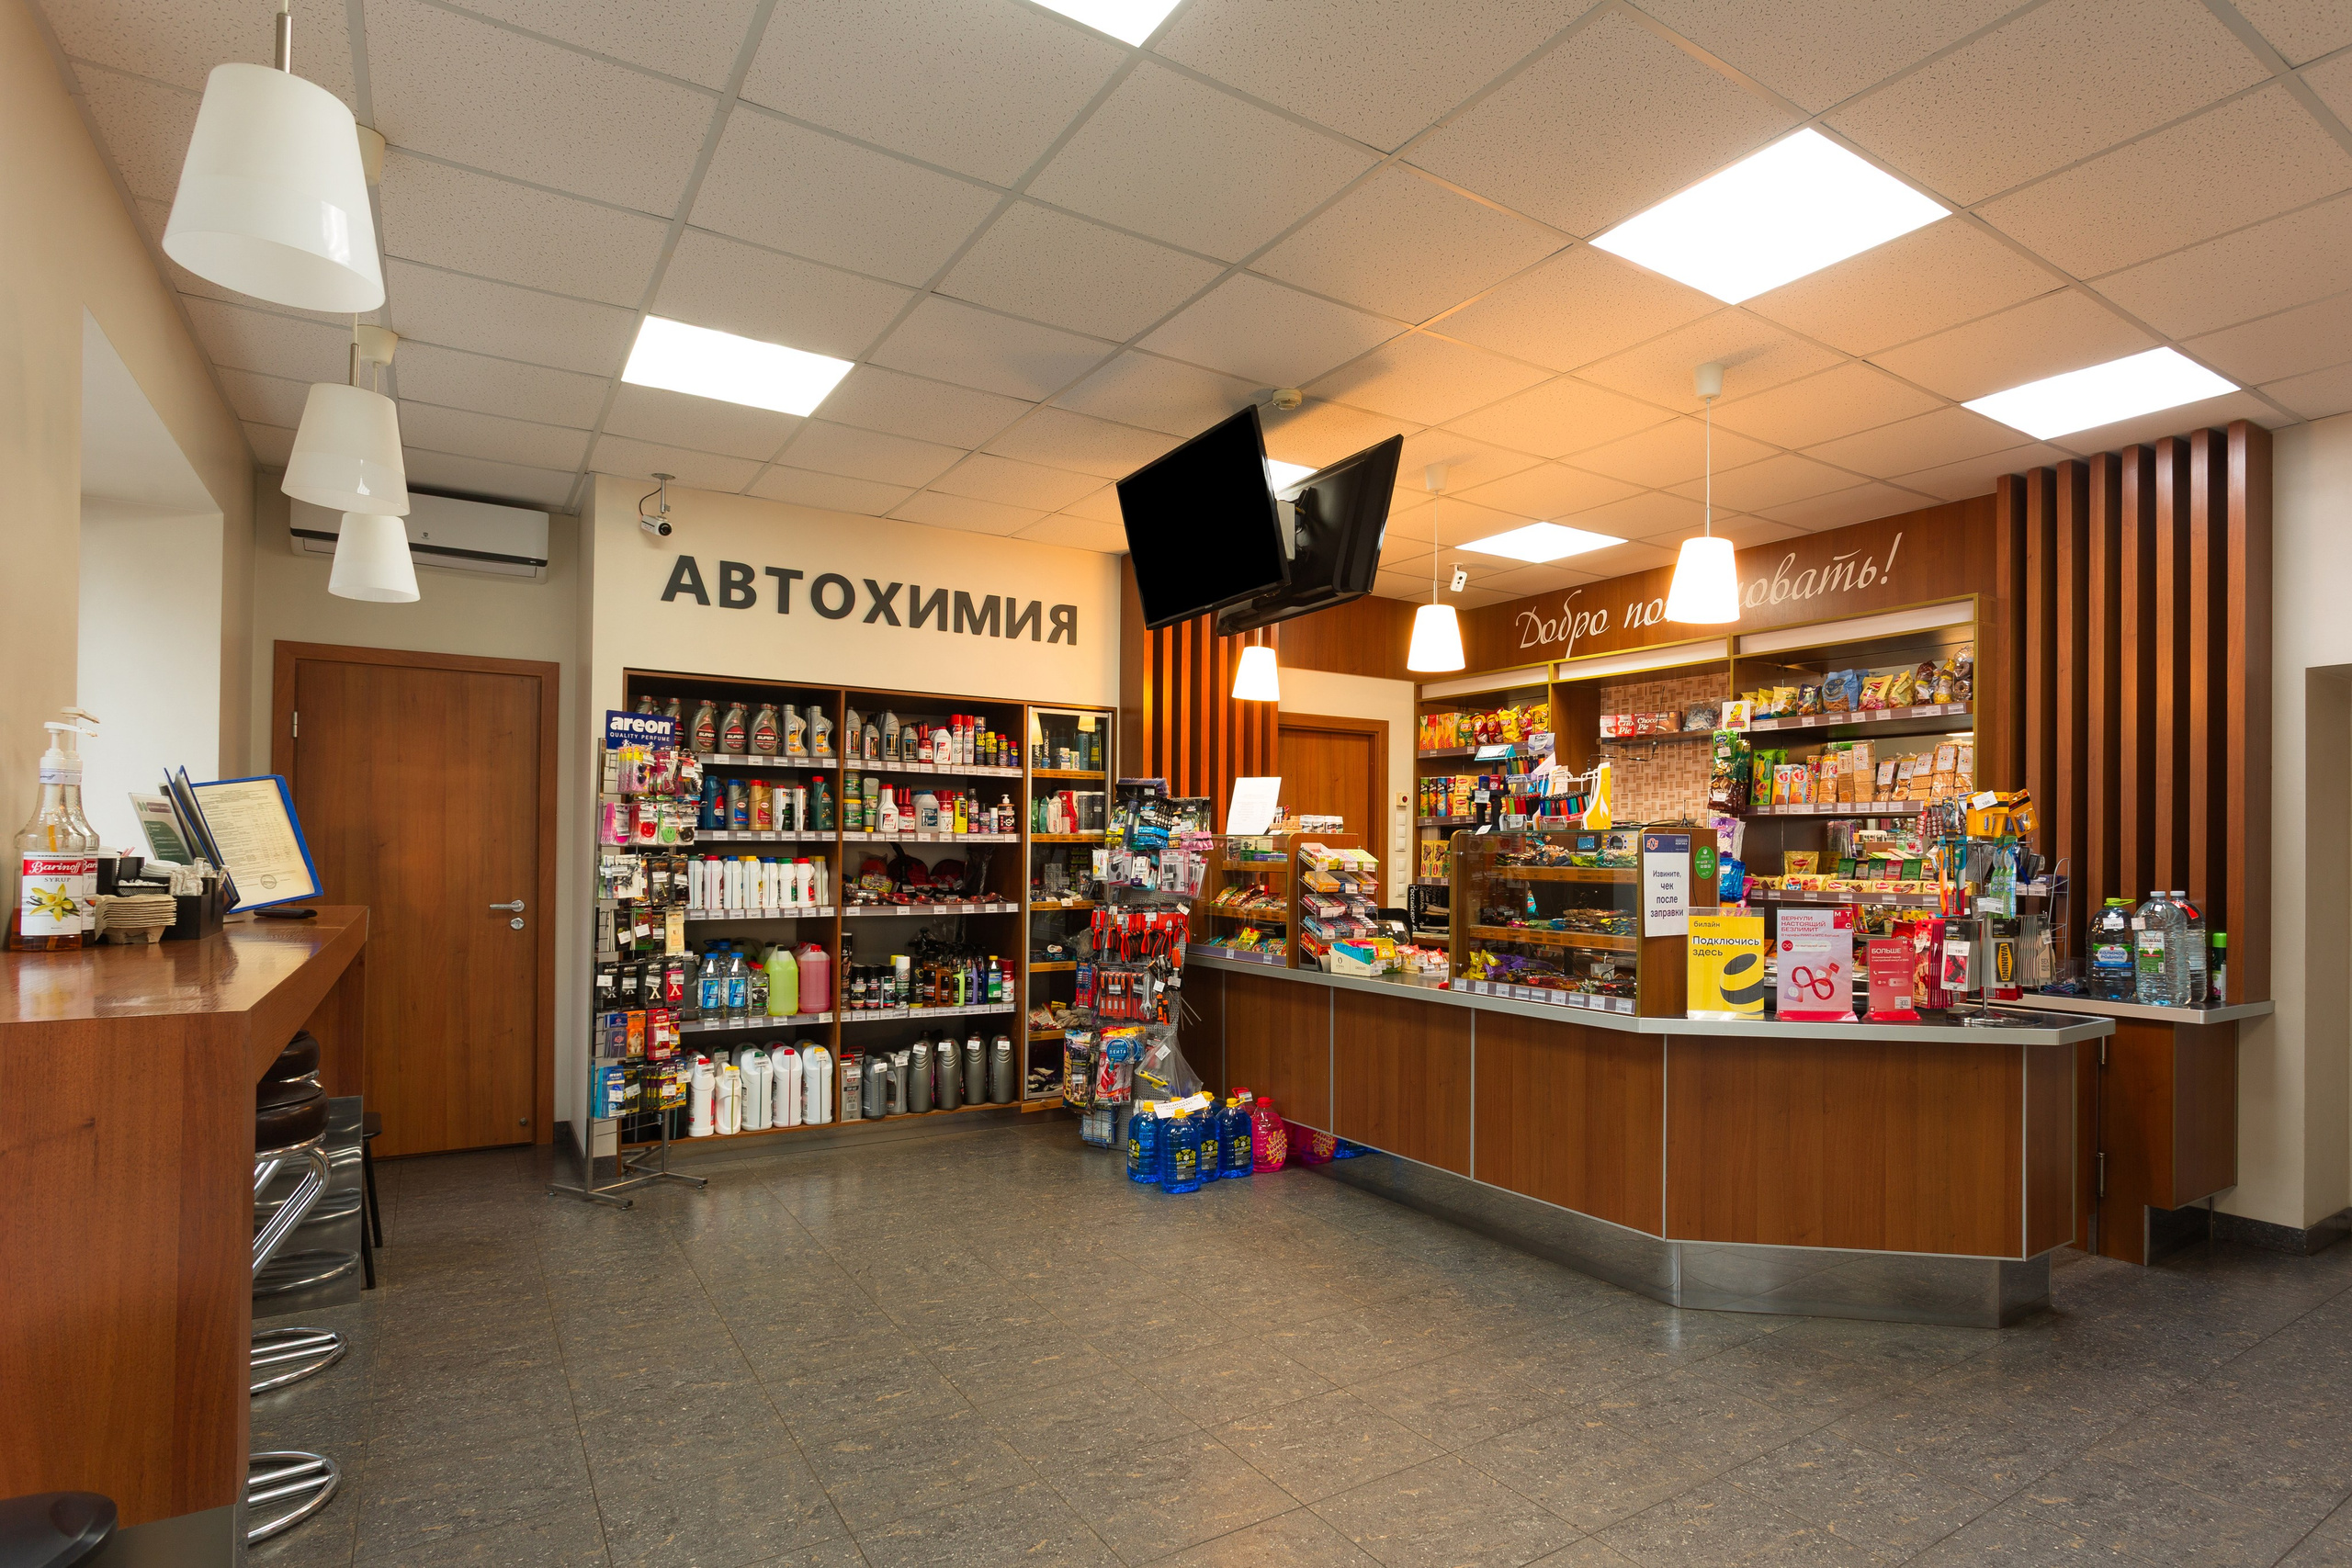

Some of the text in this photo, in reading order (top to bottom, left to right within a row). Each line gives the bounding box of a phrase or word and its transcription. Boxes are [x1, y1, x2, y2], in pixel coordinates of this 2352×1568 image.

[661, 555, 1078, 646] АВТОХИМИЯ
[1516, 532, 1903, 659] Добро поовать!
[610, 716, 671, 735] areon
[1636, 716, 1657, 725] Choco
[1618, 726, 1632, 735] Pie
[1638, 723, 1649, 731] Pie
[609, 731, 670, 742] QUALITY PERFUME
[28, 861, 82, 874] Barinoff
[1653, 870, 1681, 878] Извините,
[1657, 896, 1679, 904] после
[1650, 909, 1683, 919] заправки
[1692, 935, 1760, 946] Подключись
[1692, 949, 1724, 957] здесь
[2001, 944, 2009, 980] WARNING
